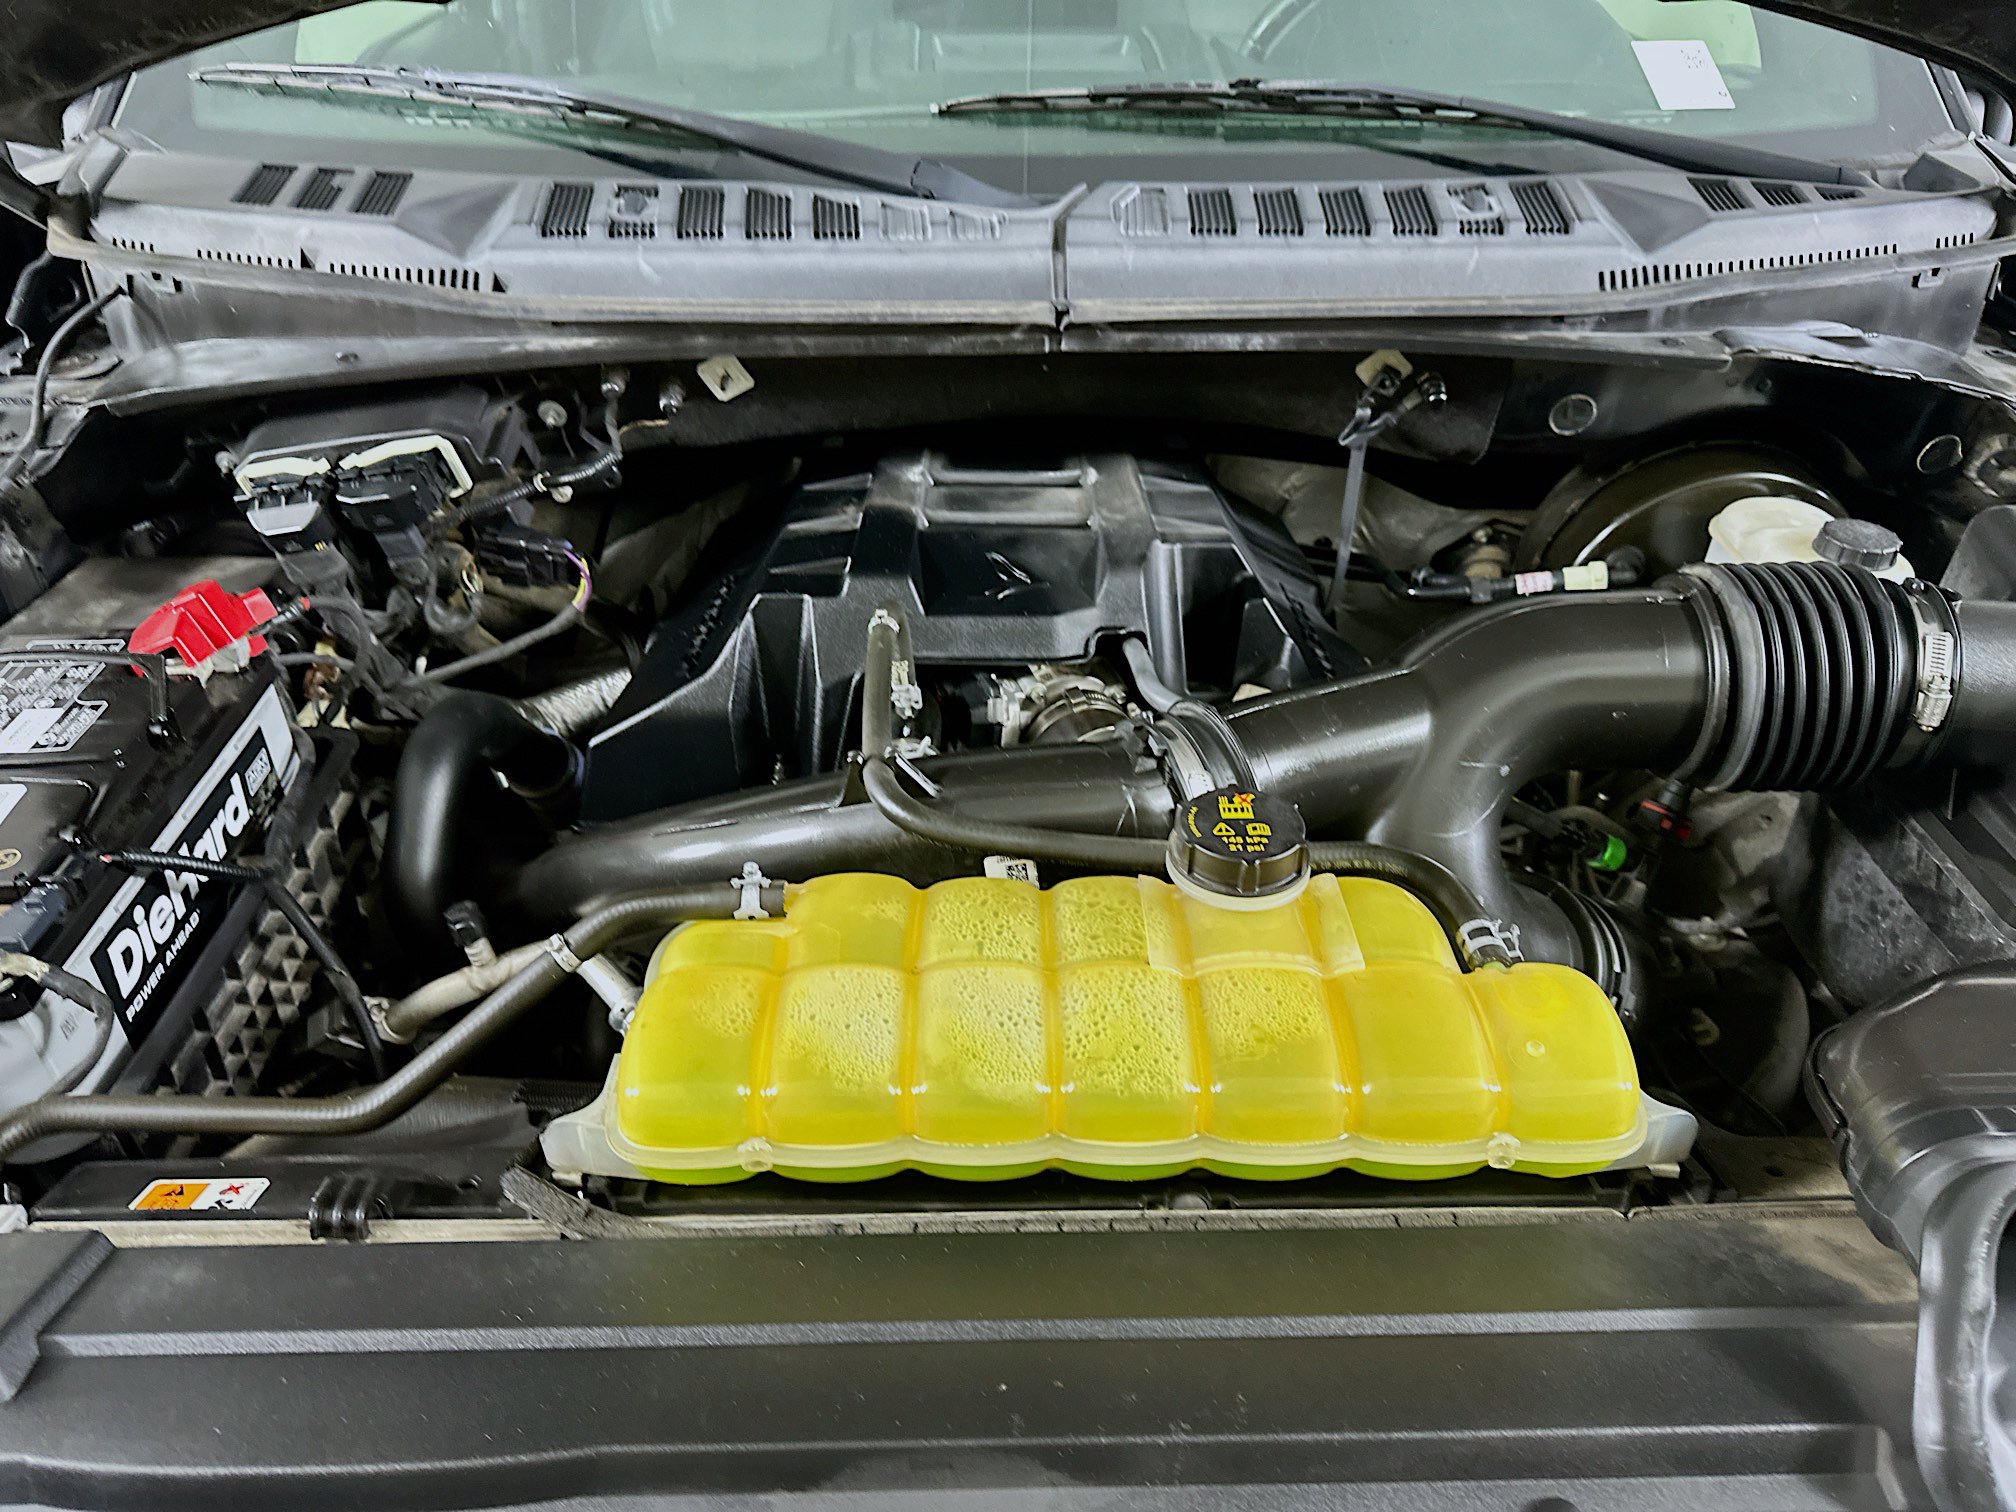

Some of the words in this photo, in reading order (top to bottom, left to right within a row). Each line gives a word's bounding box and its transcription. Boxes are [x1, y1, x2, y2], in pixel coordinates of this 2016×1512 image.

[107, 772, 251, 1000] DieHard
[125, 962, 167, 1023] POWER
[164, 913, 200, 967] AHEAD
